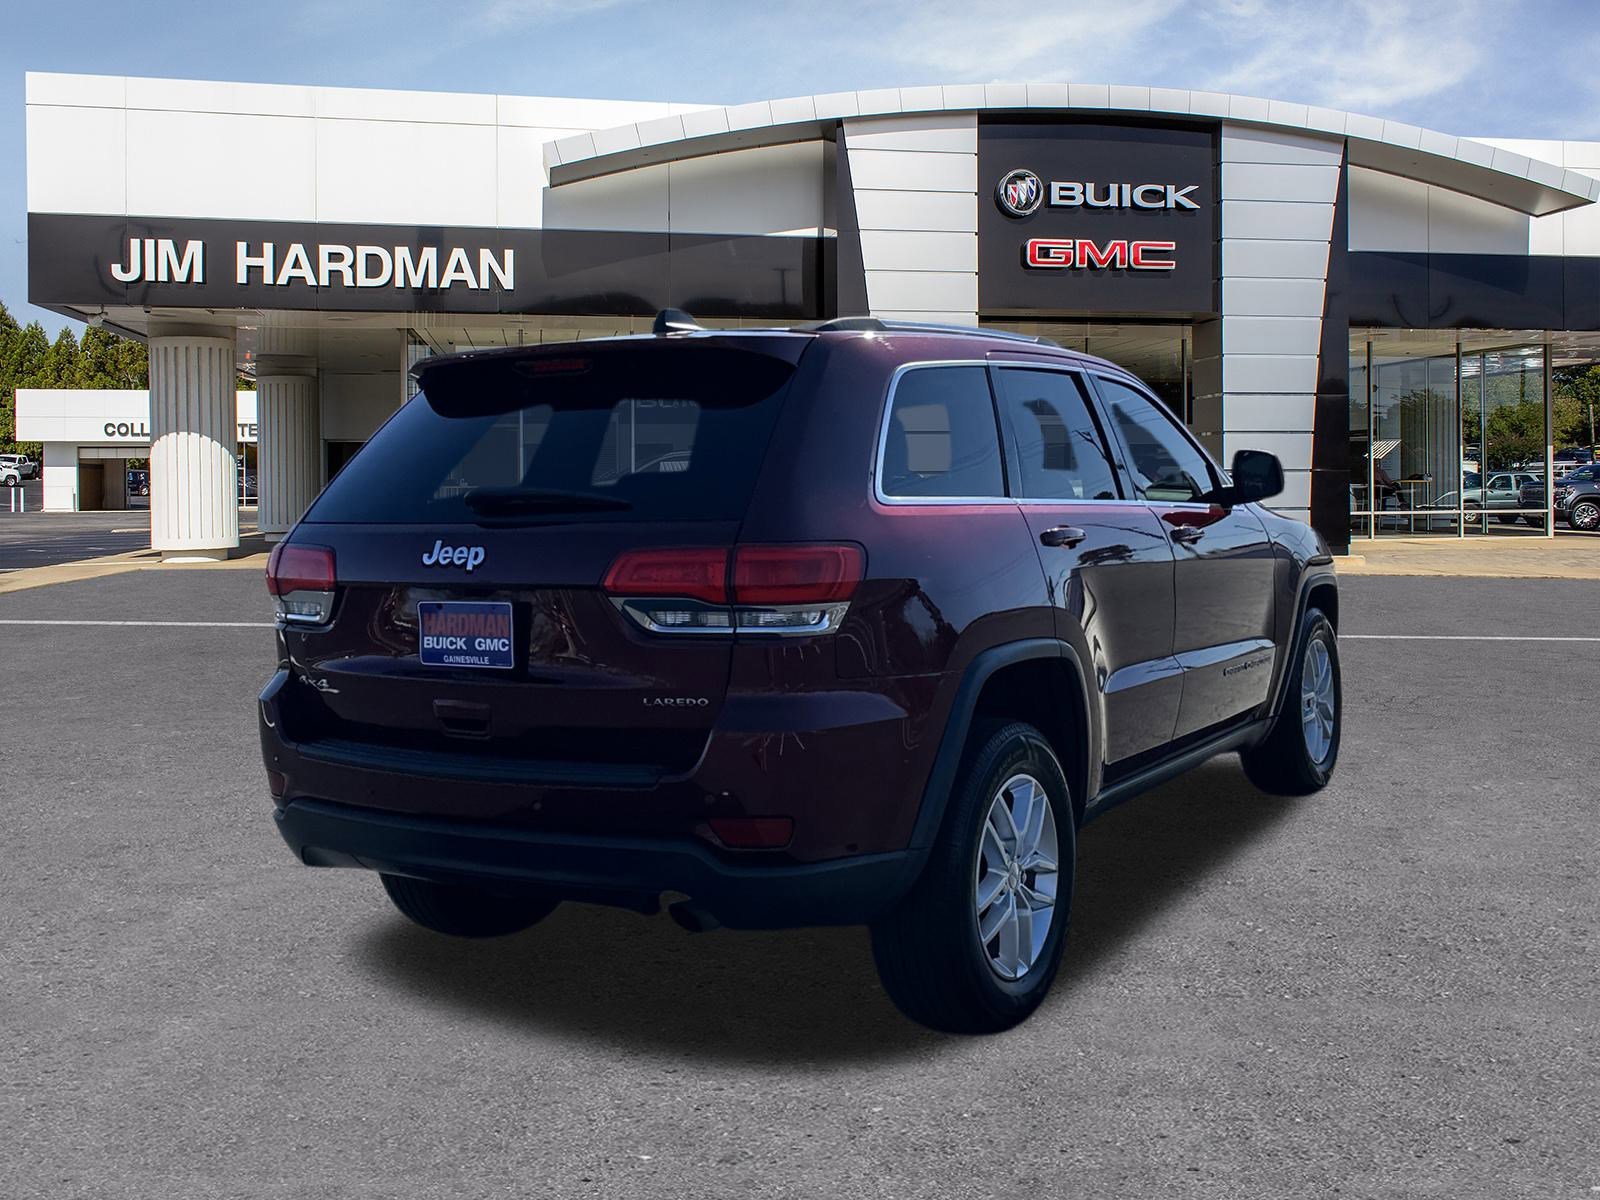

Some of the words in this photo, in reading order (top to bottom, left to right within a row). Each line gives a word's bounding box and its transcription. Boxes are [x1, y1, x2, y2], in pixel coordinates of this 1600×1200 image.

[1050, 181, 1200, 209] BUICK
[111, 238, 203, 283] JIM
[236, 242, 515, 290] HARDMAN
[1026, 238, 1176, 270] GMC
[104, 422, 150, 437] COLL
[237, 423, 258, 437] TE
[421, 540, 486, 571] Jeep
[423, 612, 510, 637] HARDMAN
[423, 636, 467, 650] BUICK
[474, 638, 510, 651] GMC
[443, 655, 490, 665] GAINESVILLE
[642, 697, 709, 707] LAREDO
